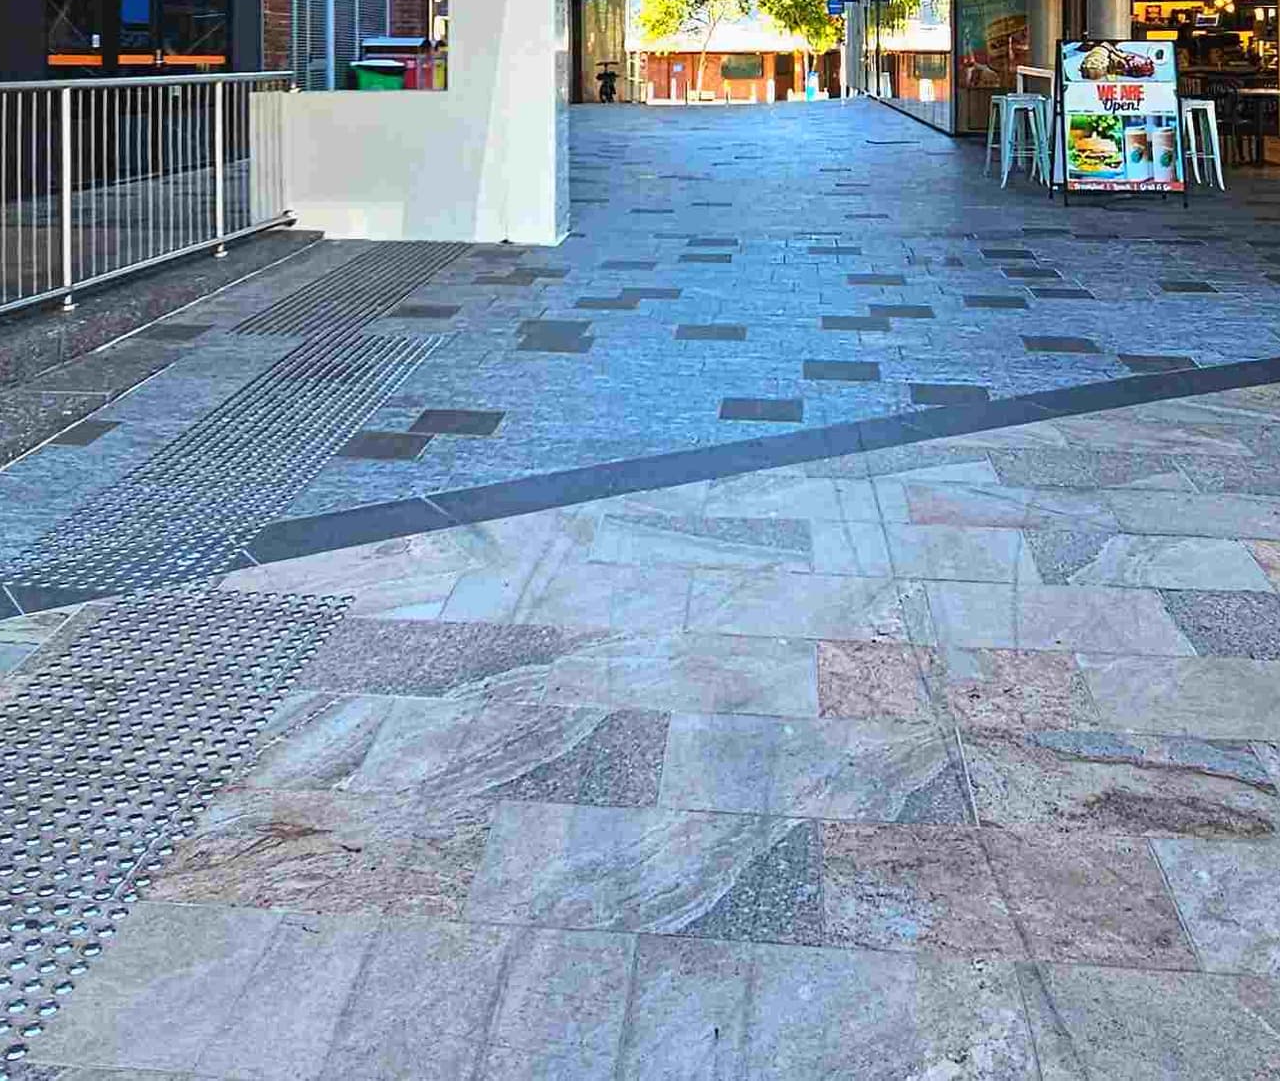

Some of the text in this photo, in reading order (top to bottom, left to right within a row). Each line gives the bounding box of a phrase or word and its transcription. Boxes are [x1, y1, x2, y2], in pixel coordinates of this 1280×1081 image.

[1097, 84, 1145, 101] WE ARE
[1103, 99, 1141, 115] Open!
